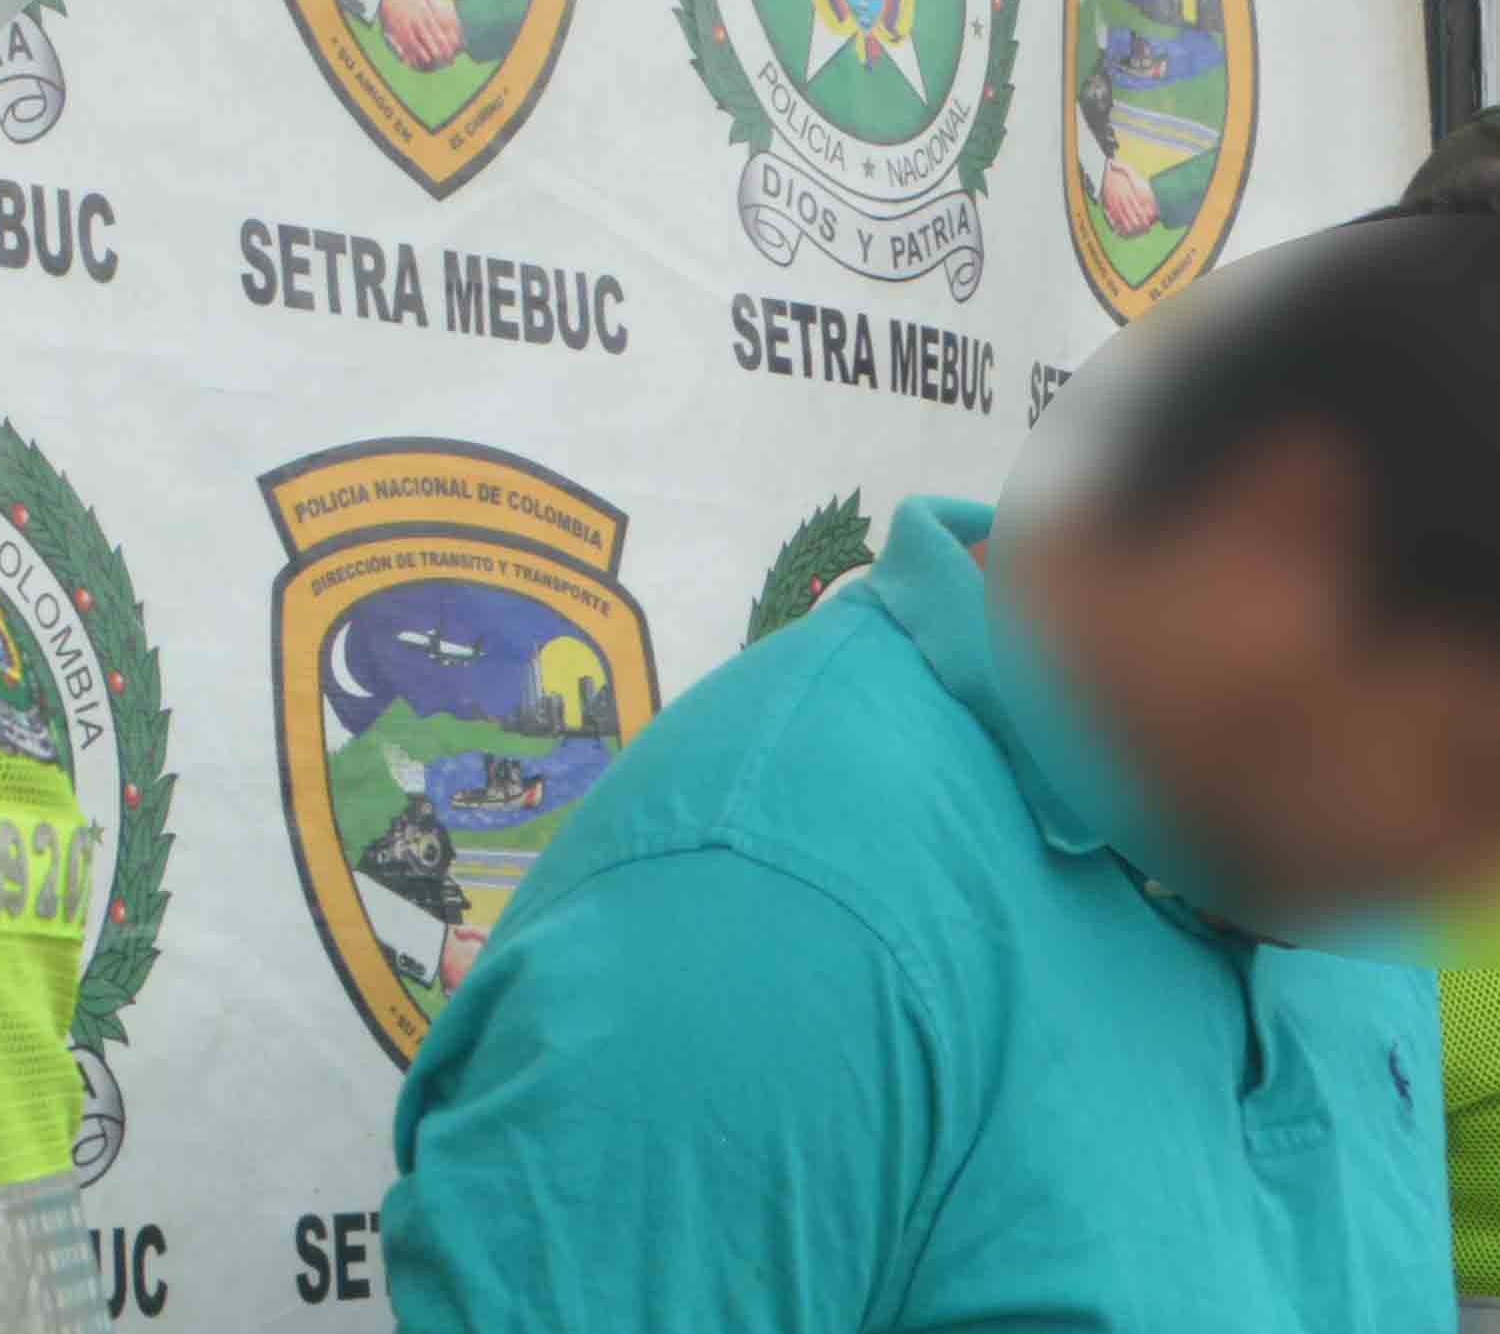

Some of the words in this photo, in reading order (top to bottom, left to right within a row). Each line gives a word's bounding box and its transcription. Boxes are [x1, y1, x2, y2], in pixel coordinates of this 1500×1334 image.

[756, 60, 847, 172] POLICIA
[884, 97, 972, 188] NACIONAL
[761, 162, 837, 243] DIOS
[856, 228, 874, 265] Y
[889, 201, 972, 271] PATRIA
[239, 217, 429, 328] SETRA
[442, 248, 628, 356] MEBUC
[730, 291, 879, 390] SETRA
[888, 318, 995, 416] MEBUC
[294, 486, 371, 524] POLICIA
[373, 475, 473, 501] NACIONAL
[476, 481, 503, 506] DE
[506, 490, 603, 550] COLOMBIA
[394, 550, 417, 568] DE
[419, 551, 495, 574] TRANSITO
[497, 559, 509, 575] Y
[513, 562, 612, 618] TRANSPORTE
